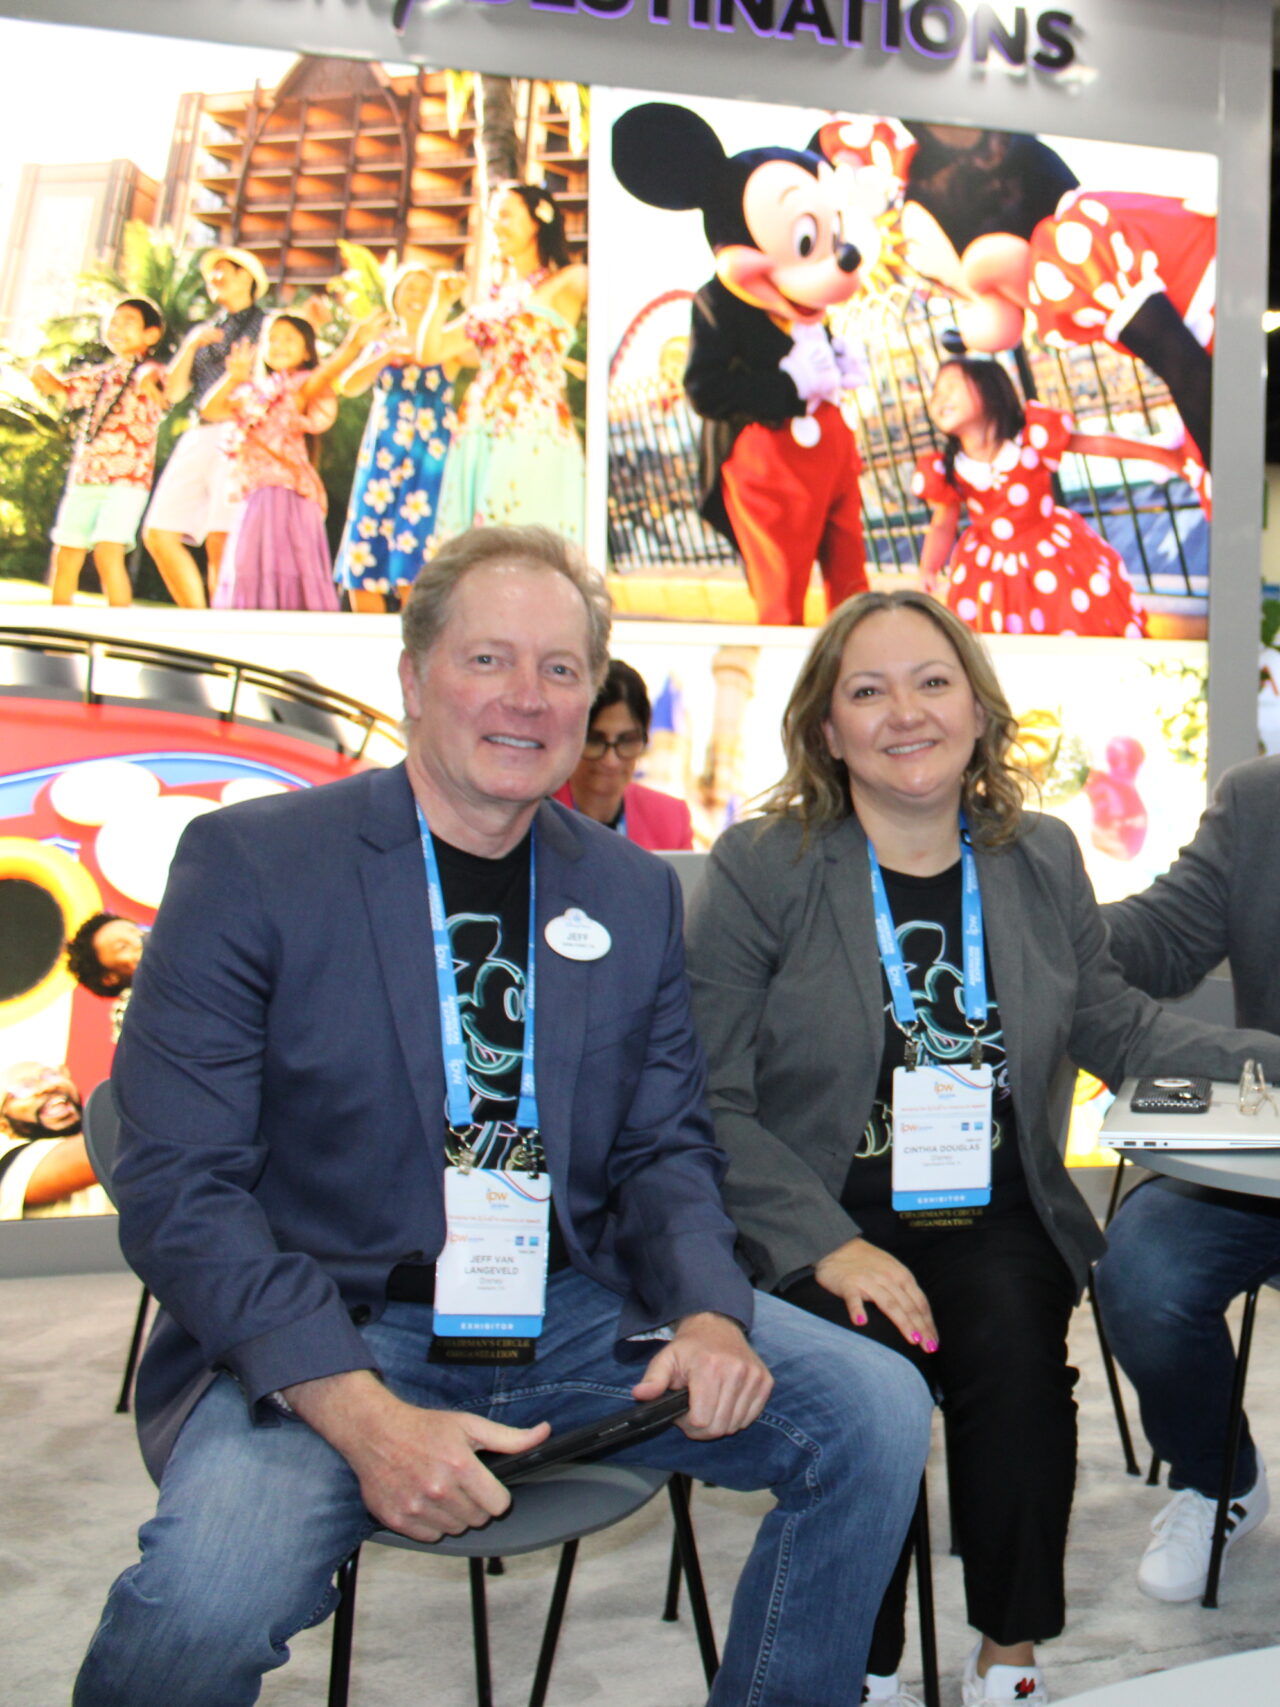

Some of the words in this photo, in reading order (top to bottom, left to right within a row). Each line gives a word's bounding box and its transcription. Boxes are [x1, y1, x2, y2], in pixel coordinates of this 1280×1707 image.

[434, 944, 449, 970] ipw
[887, 965, 902, 987] ipw
[446, 995, 460, 1045] AMERICAN
[447, 1059, 464, 1085] ipw
[934, 1081, 954, 1094] ipw
[903, 1146, 937, 1154] CINTHIA
[940, 1144, 981, 1152] DOUGLAS
[485, 1187, 508, 1203] ipw
[917, 1195, 966, 1205] EXHIBITOR
[470, 1256, 492, 1264] JEFF
[494, 1256, 514, 1264] VAN
[464, 1267, 519, 1275] LANGEVELD
[460, 1322, 514, 1331] EXHIBITOR
